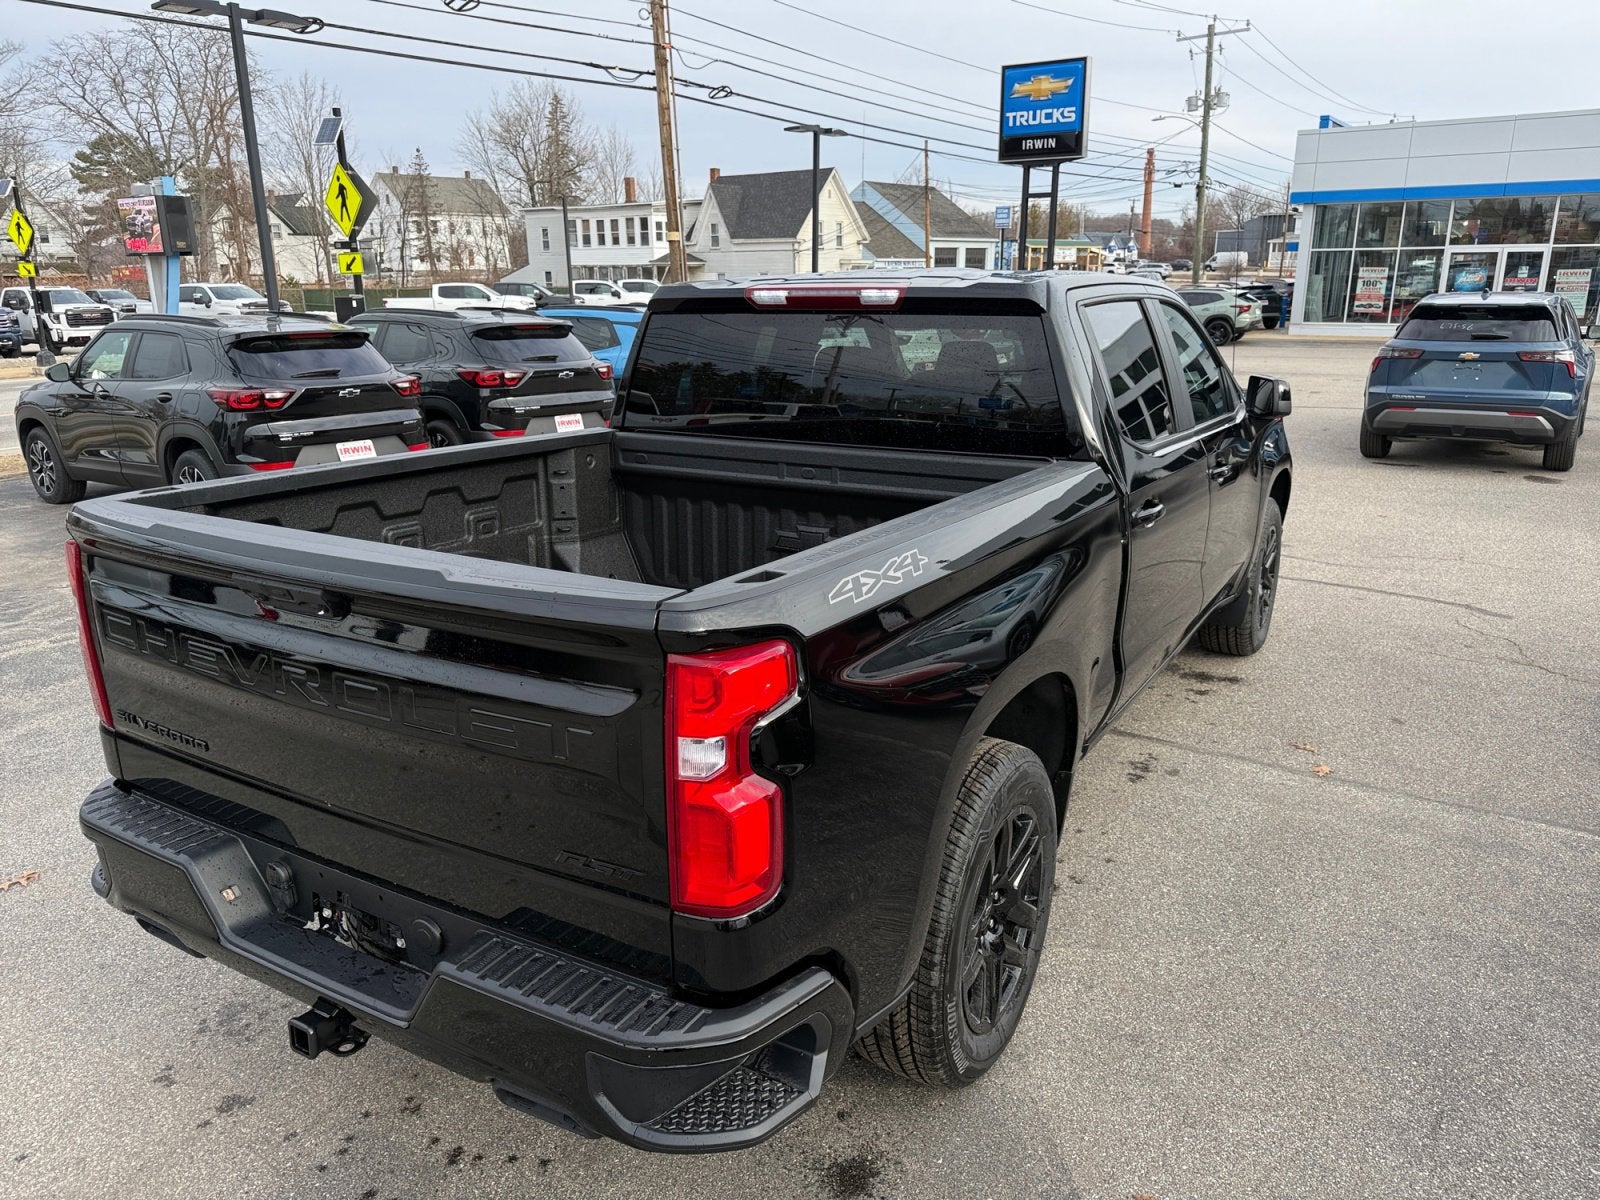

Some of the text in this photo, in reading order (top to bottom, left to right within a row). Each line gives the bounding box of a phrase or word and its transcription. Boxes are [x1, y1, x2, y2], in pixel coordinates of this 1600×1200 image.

[1005, 106, 1076, 127] TRUCKS
[1022, 137, 1056, 150] IRWIN
[557, 418, 581, 427] IRWIN
[340, 445, 372, 456] IRWIN
[101, 608, 597, 761] CHEVROLET
[116, 708, 210, 752] SILVERADO
[555, 849, 647, 880] RST
